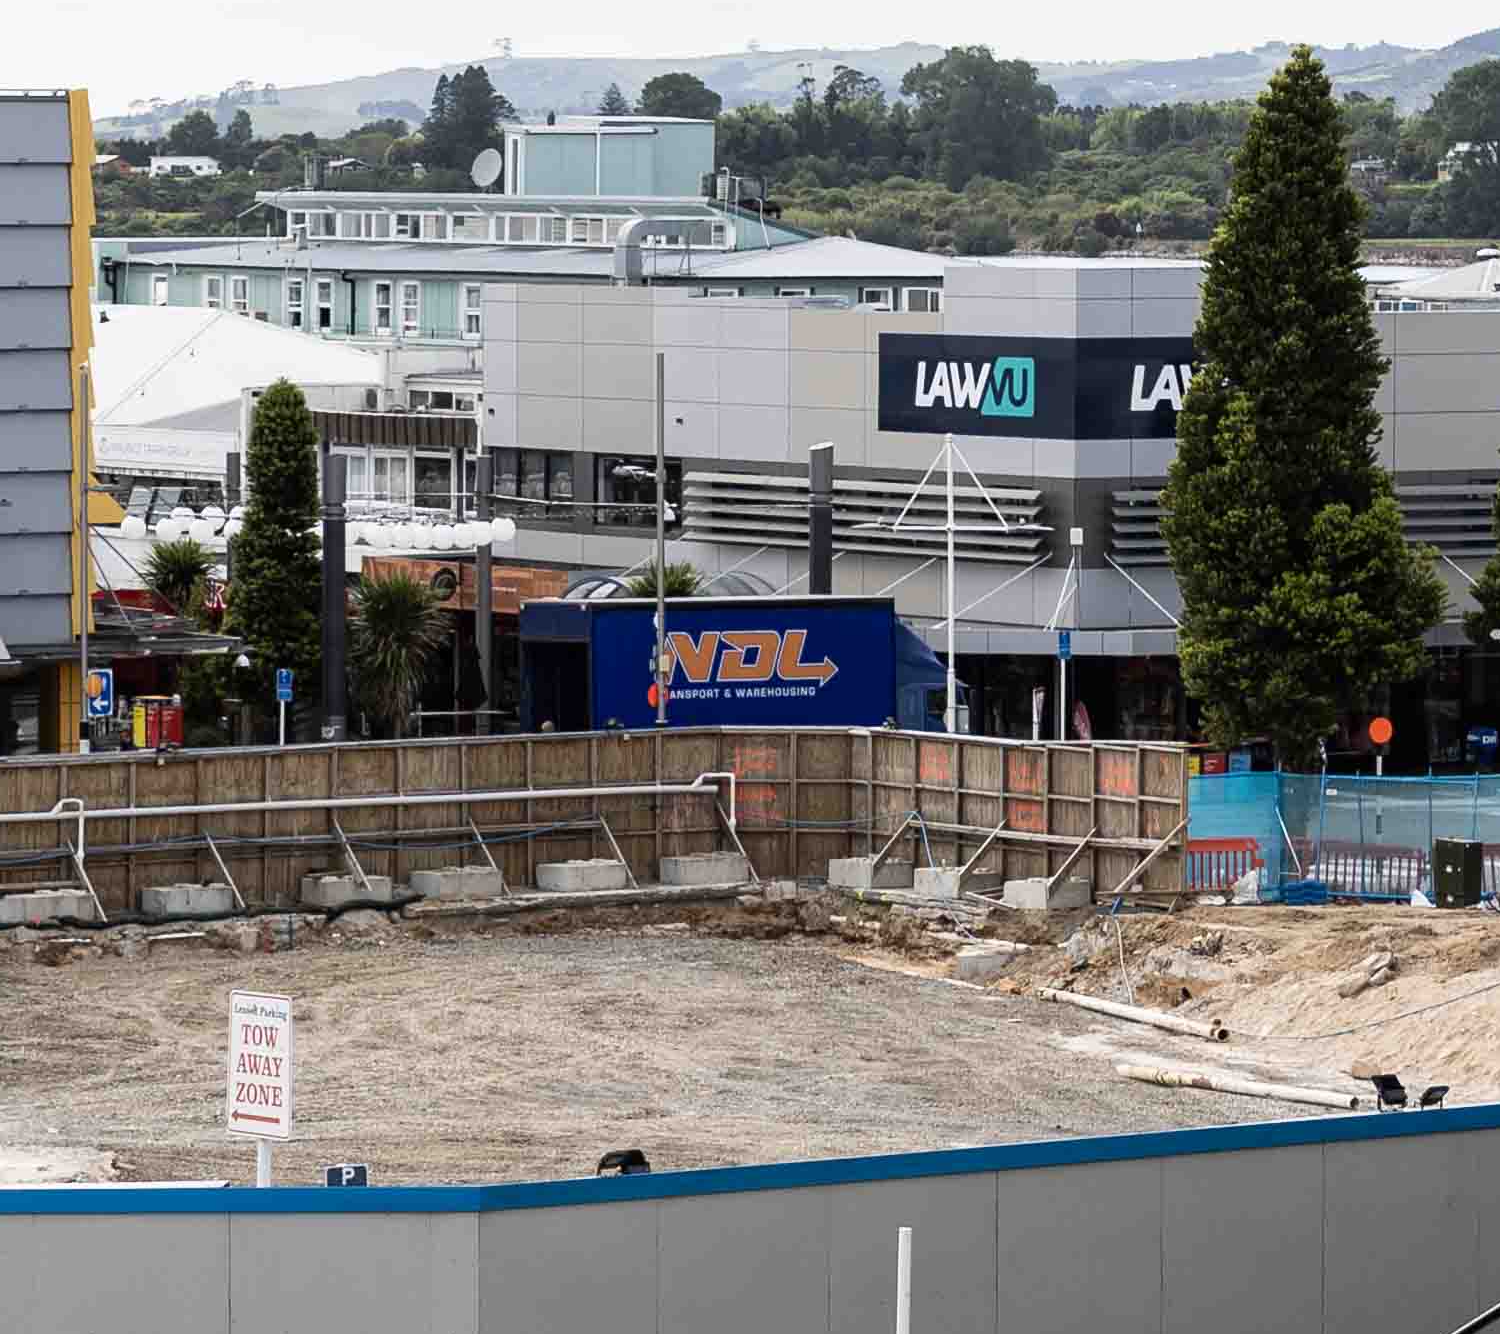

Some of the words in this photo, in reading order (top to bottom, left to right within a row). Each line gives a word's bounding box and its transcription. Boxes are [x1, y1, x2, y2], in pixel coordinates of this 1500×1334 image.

[914, 360, 1030, 411] LAWVU
[654, 629, 839, 686] NDL
[724, 688, 732, 699] &
[735, 685, 817, 699] WAREHOUSING
[241, 1023, 280, 1048] TOW
[235, 1052, 283, 1077] AWAY
[235, 1082, 283, 1108] ZONE
[342, 1167, 355, 1186] P
